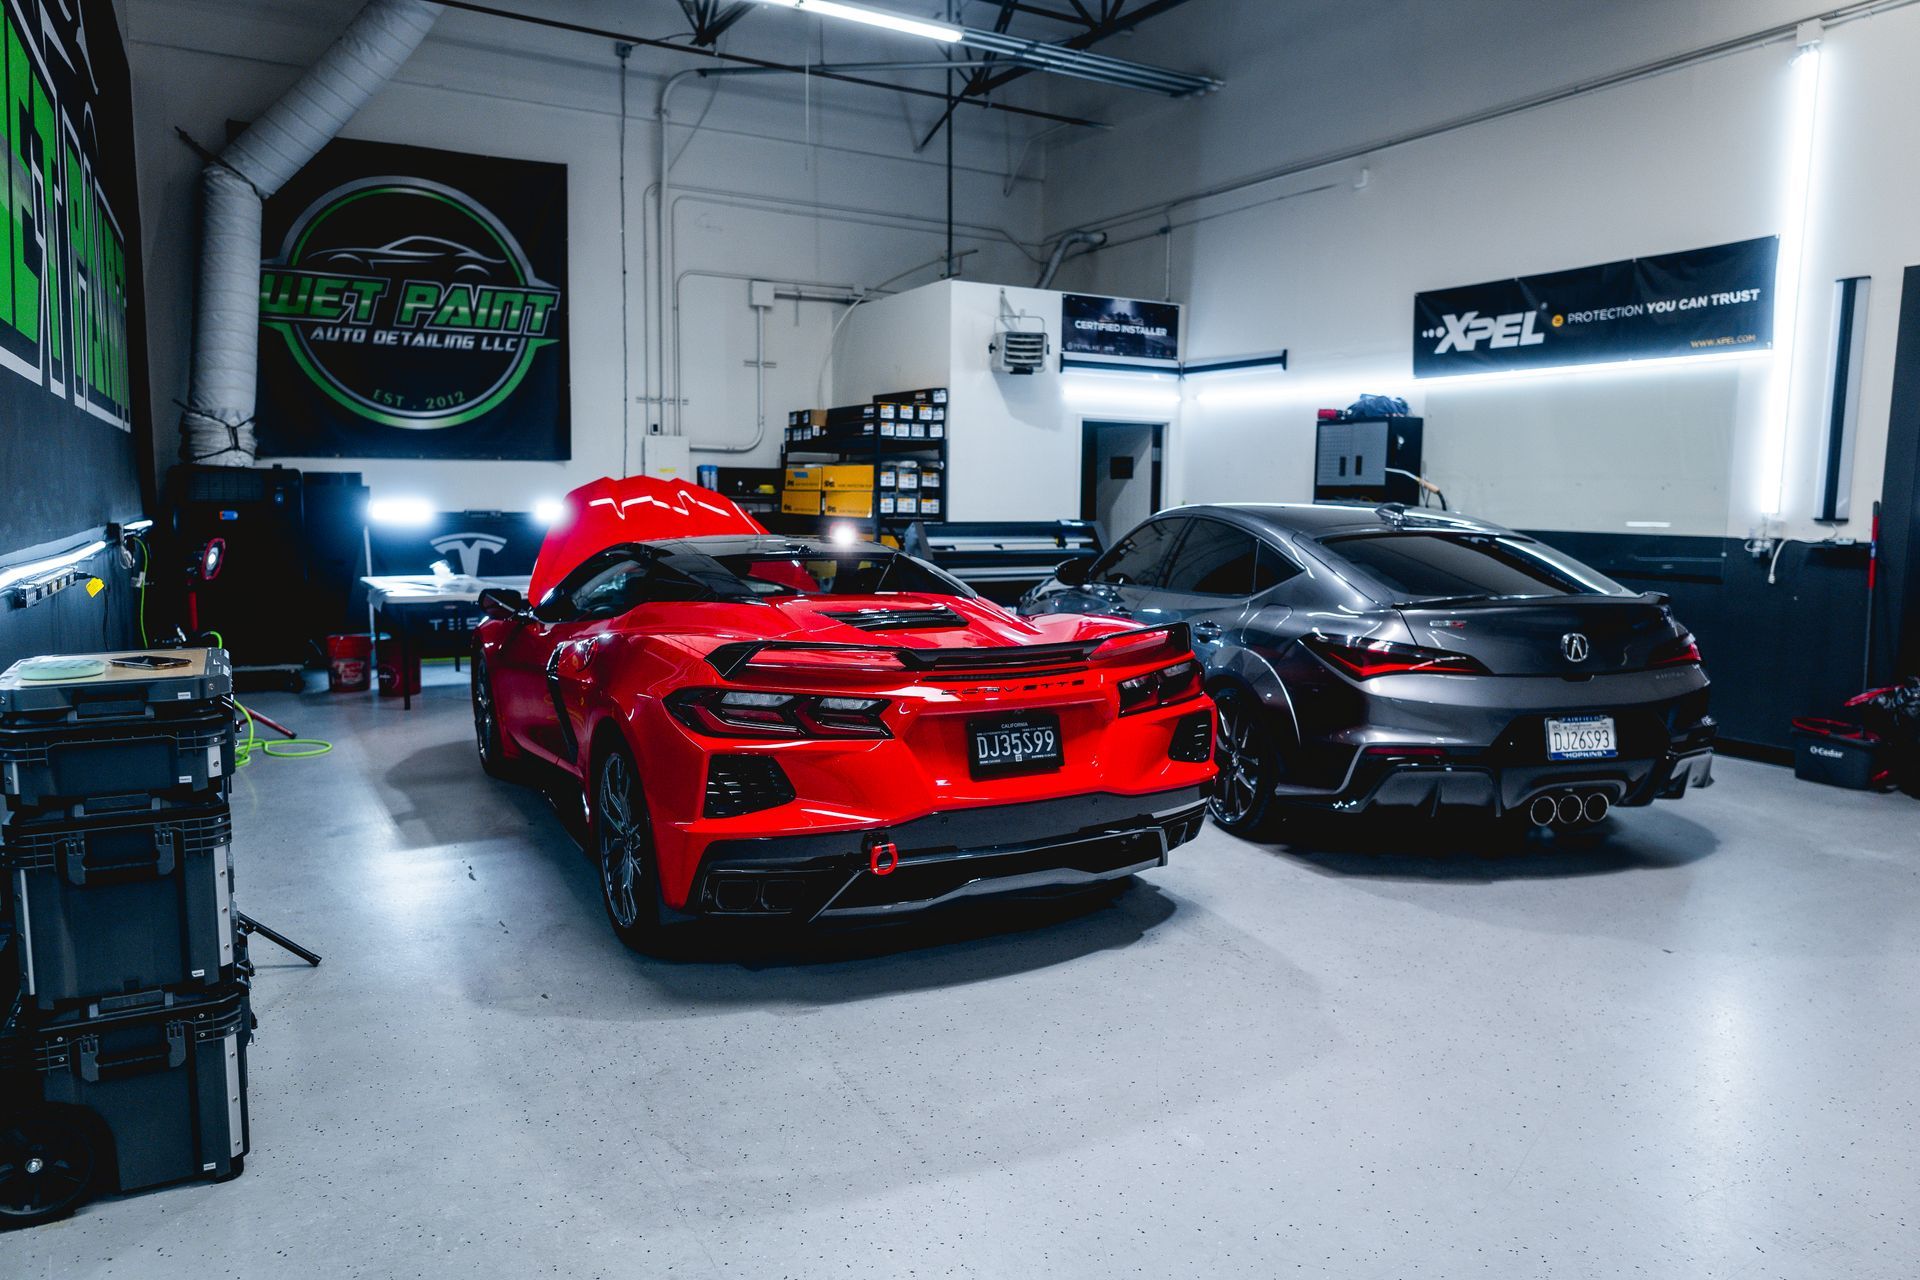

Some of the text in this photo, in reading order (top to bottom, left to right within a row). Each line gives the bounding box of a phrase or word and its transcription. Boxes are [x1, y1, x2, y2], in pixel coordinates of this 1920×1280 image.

[0, 0, 65, 399] ET
[260, 268, 560, 336] WET PAINT
[1567, 289, 1761, 325] PROTECTION YOU CAN TRUST
[310, 326, 520, 351] AUTO DETAILING LLC
[1074, 320, 1168, 337] CERTIFIED INSTALLER
[1434, 310, 1545, 354] XPEL
[1690, 333, 1757, 348] WWW.XPEL.COM
[425, 390, 466, 409] 2012
[976, 730, 1055, 759] DJ35S99
[1554, 729, 1610, 751] DJ26S93
